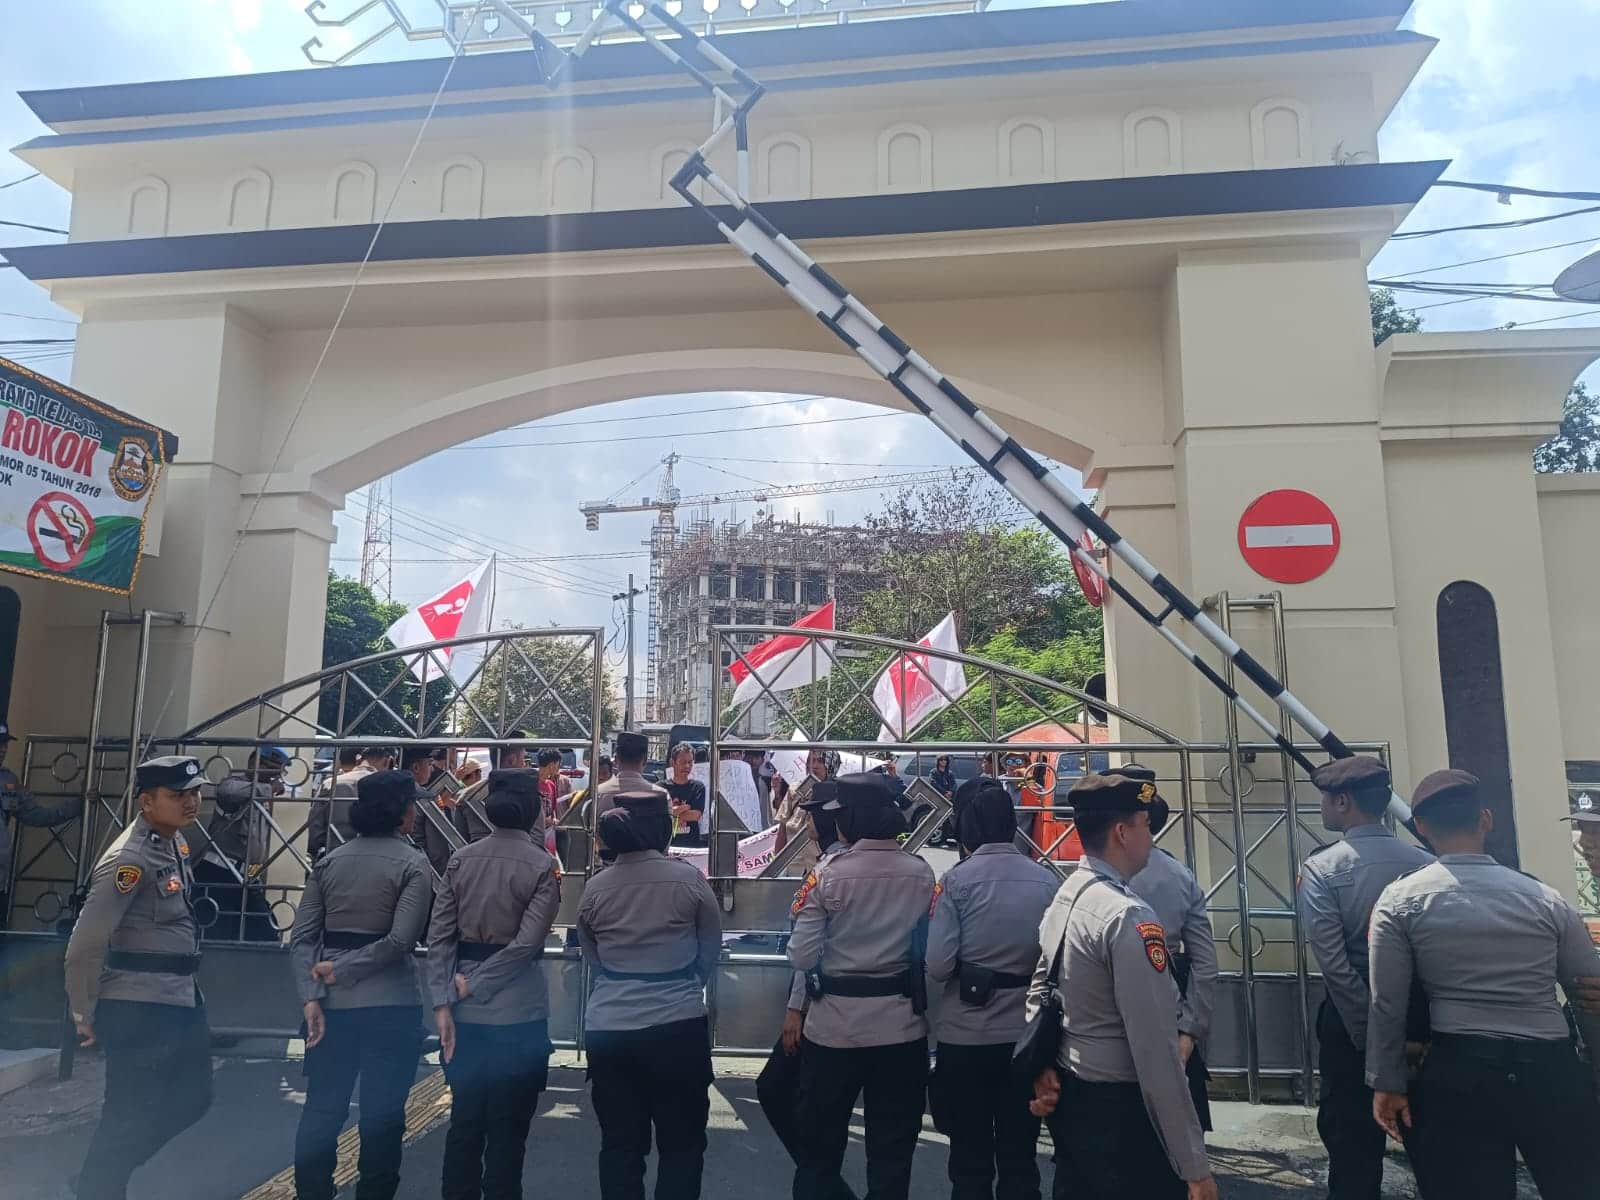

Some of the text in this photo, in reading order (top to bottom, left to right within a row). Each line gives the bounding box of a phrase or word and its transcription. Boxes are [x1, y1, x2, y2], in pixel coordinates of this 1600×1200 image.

[1, 407, 100, 477] ROKOK
[26, 464, 39, 478] 05
[41, 468, 74, 490] TAHUN
